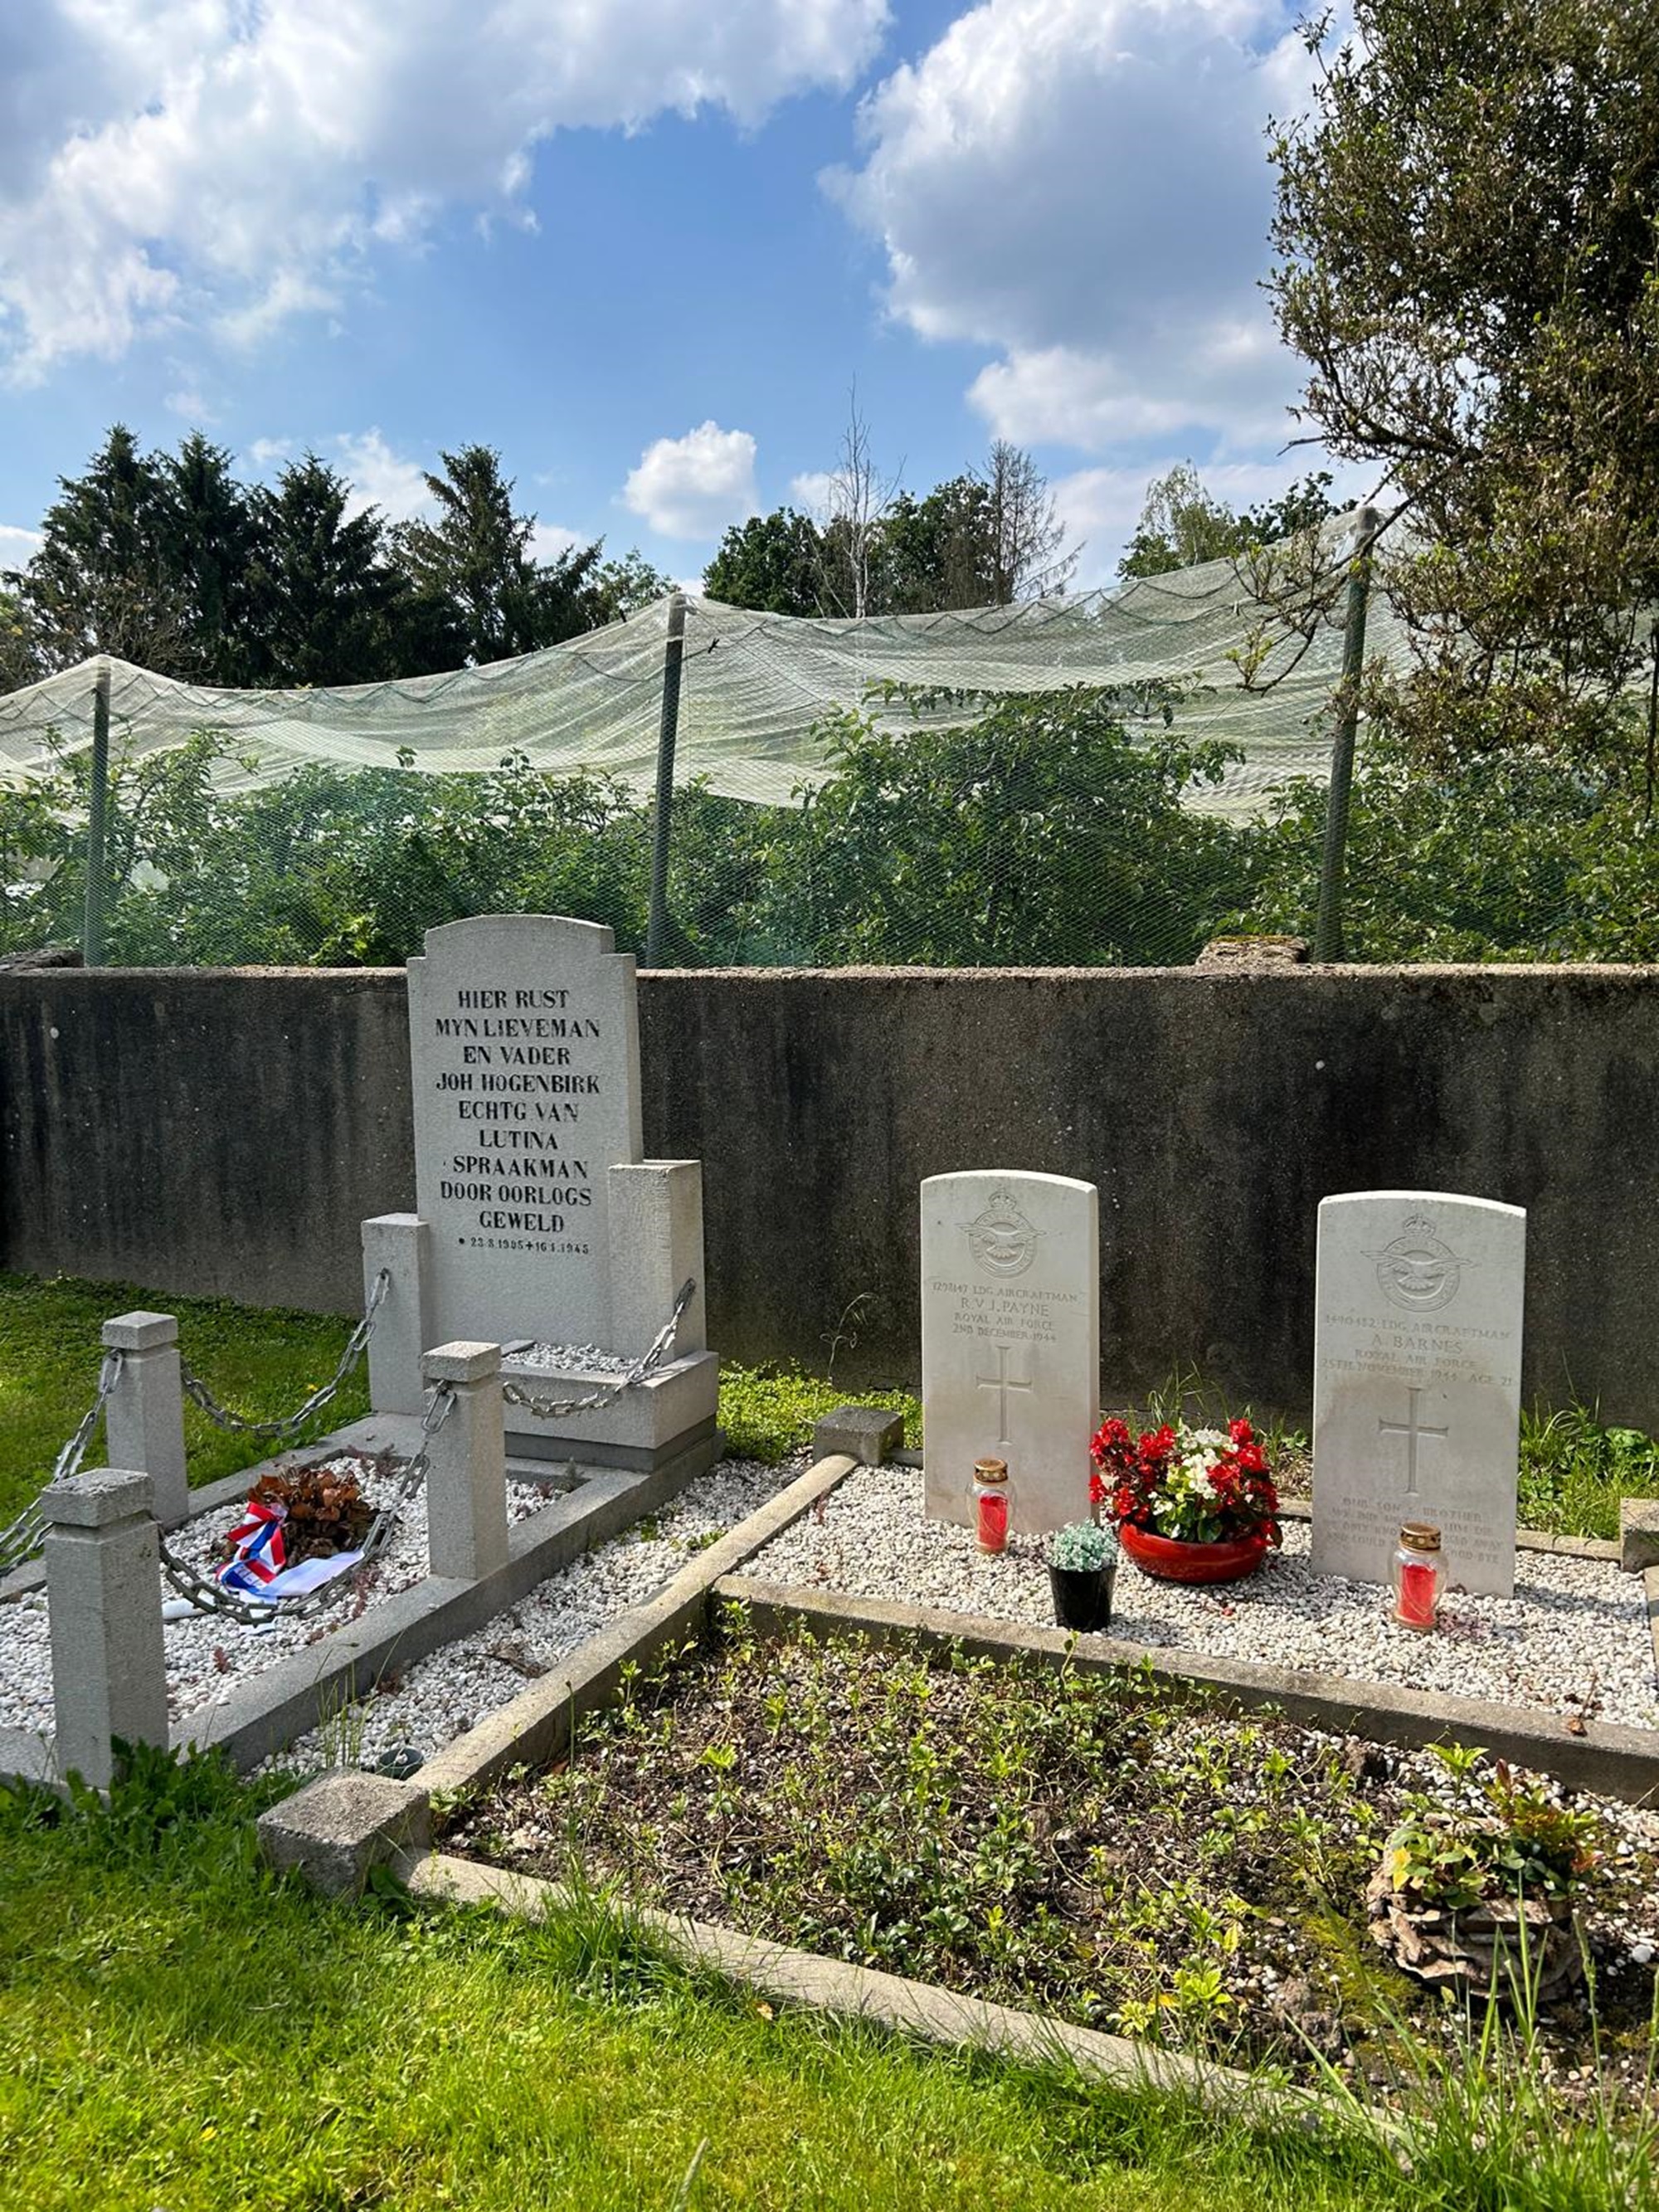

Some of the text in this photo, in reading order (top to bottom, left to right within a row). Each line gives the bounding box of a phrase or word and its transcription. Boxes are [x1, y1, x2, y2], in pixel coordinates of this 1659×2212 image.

[458, 989, 570, 1009] HIER RUST
[435, 1018, 478, 1037] MYN
[463, 1045, 571, 1065] EN VADER
[436, 1072, 601, 1094] JOH HOGENBIRK
[458, 1100, 579, 1123] ECHTG VAN
[479, 1129, 558, 1150] LUTINA
[453, 1155, 588, 1179] SPRAAKMAN
[440, 1181, 592, 1206] DOOR OORLOGS
[479, 1210, 565, 1233] GEWELD
[996, 1288, 1078, 1303] AIRCRAFTMAN
[951, 1323, 974, 1335] 2ND
[977, 1327, 1029, 1339] DECEMBER
[954, 1312, 1052, 1332] ROYAL AIR FORCE
[1393, 1335, 1462, 1354] BARNES
[1355, 1348, 1398, 1362] ROYAL
[1434, 1357, 1477, 1369] FORCE
